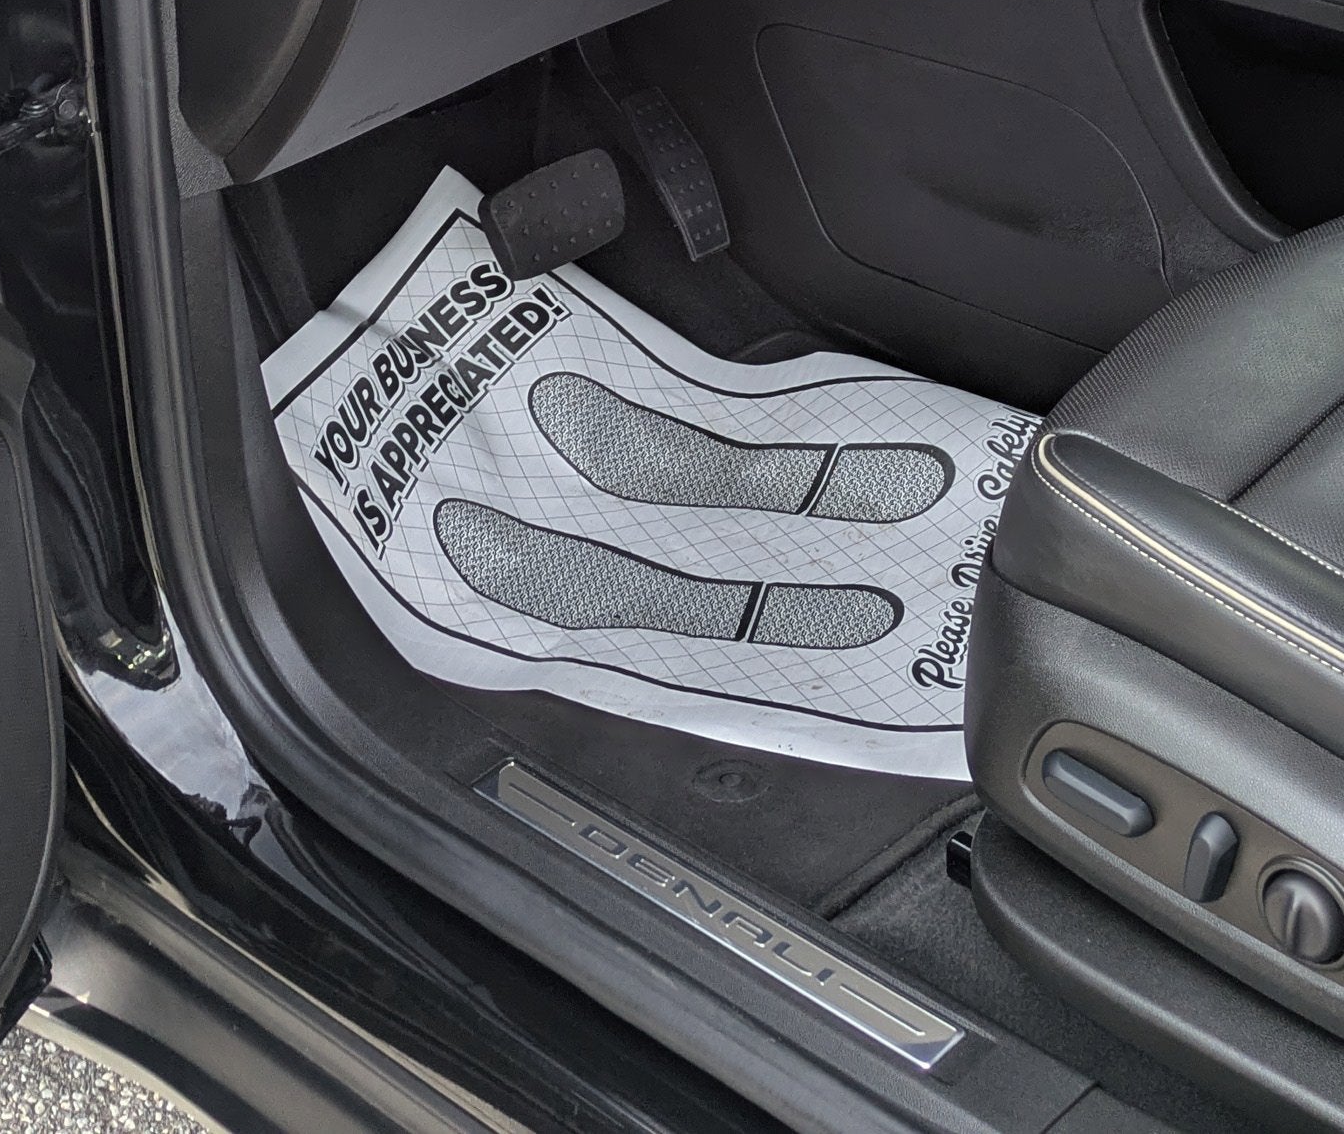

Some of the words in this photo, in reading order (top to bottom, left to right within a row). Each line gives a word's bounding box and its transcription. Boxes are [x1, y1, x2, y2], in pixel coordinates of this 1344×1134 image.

[312, 374, 386, 490] YOUR
[371, 261, 509, 402] BUNESS
[369, 287, 567, 514] APPRECIATED!
[352, 487, 390, 554] IS
[911, 598, 973, 690] Please
[578, 822, 836, 986] DENALI
